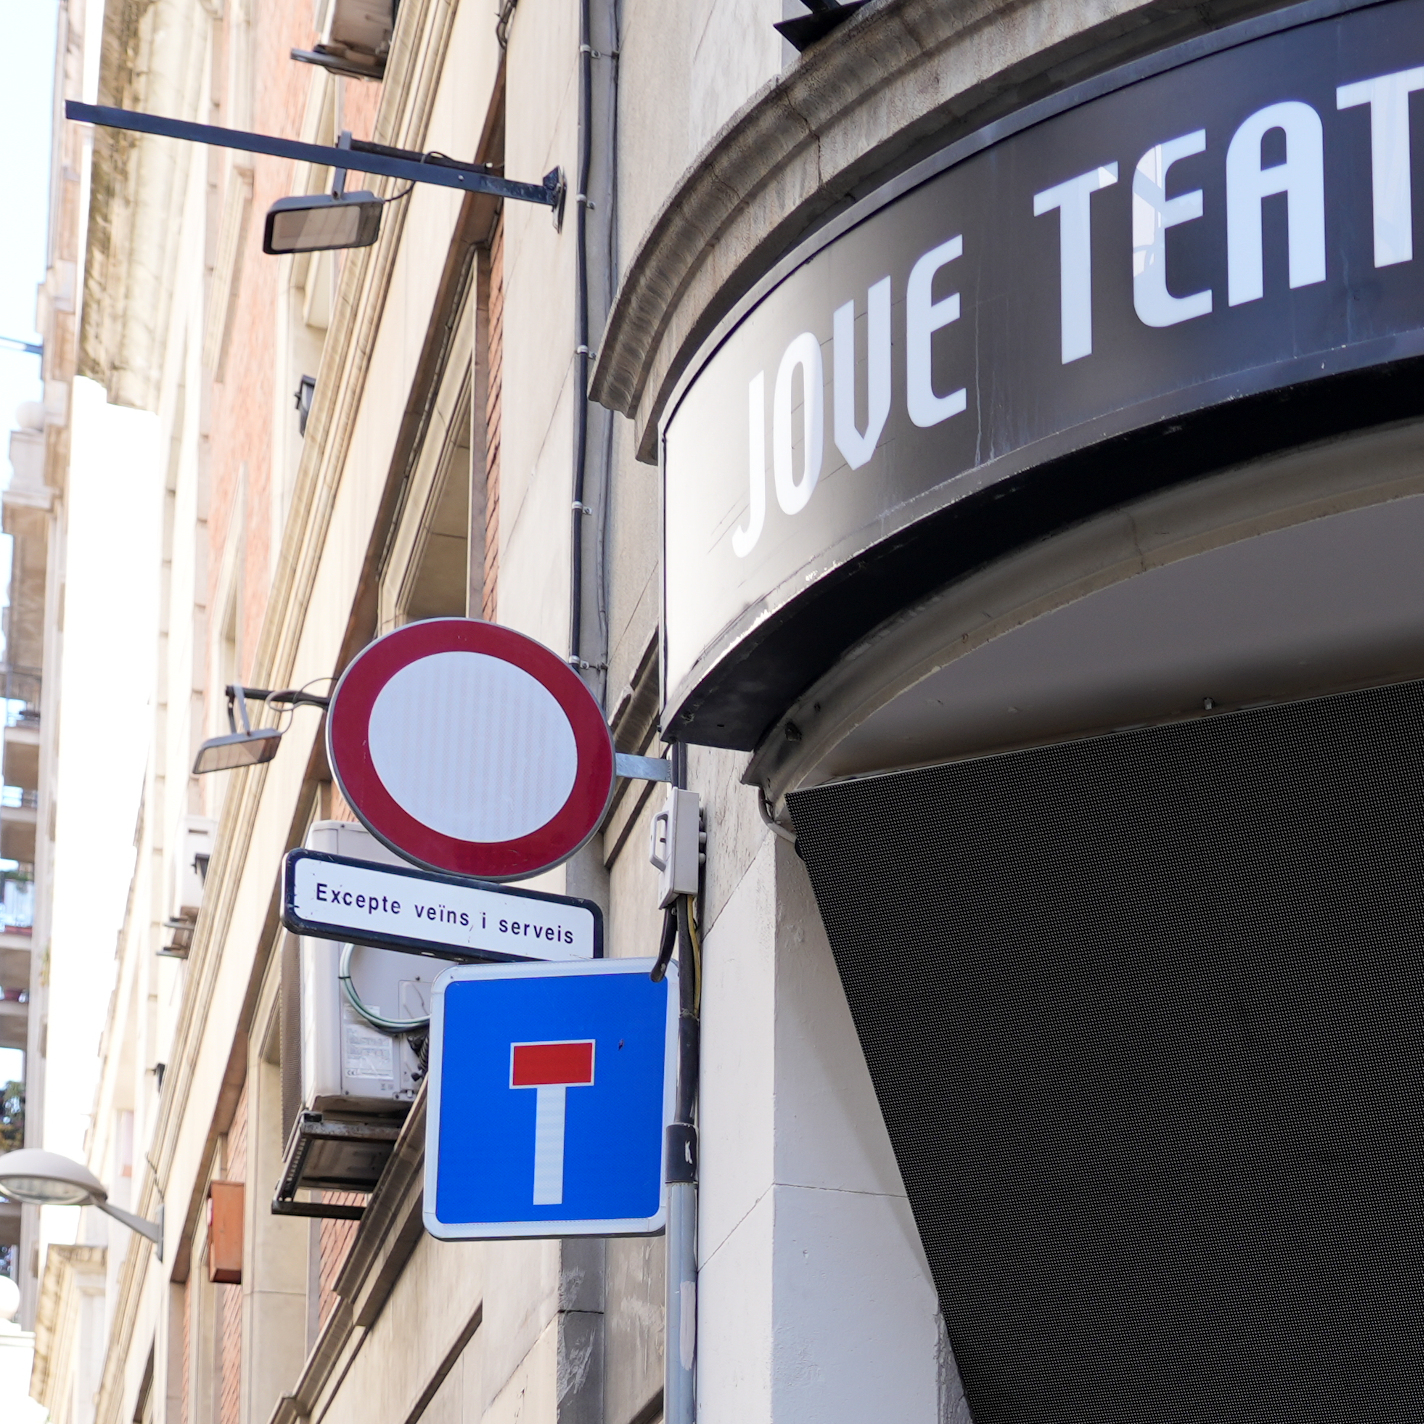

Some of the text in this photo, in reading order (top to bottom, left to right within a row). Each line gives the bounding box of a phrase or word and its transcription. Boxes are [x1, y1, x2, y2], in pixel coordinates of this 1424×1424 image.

[728, 234, 967, 559] JOVE
[315, 882, 574, 944] Excepte veïns i serveis
